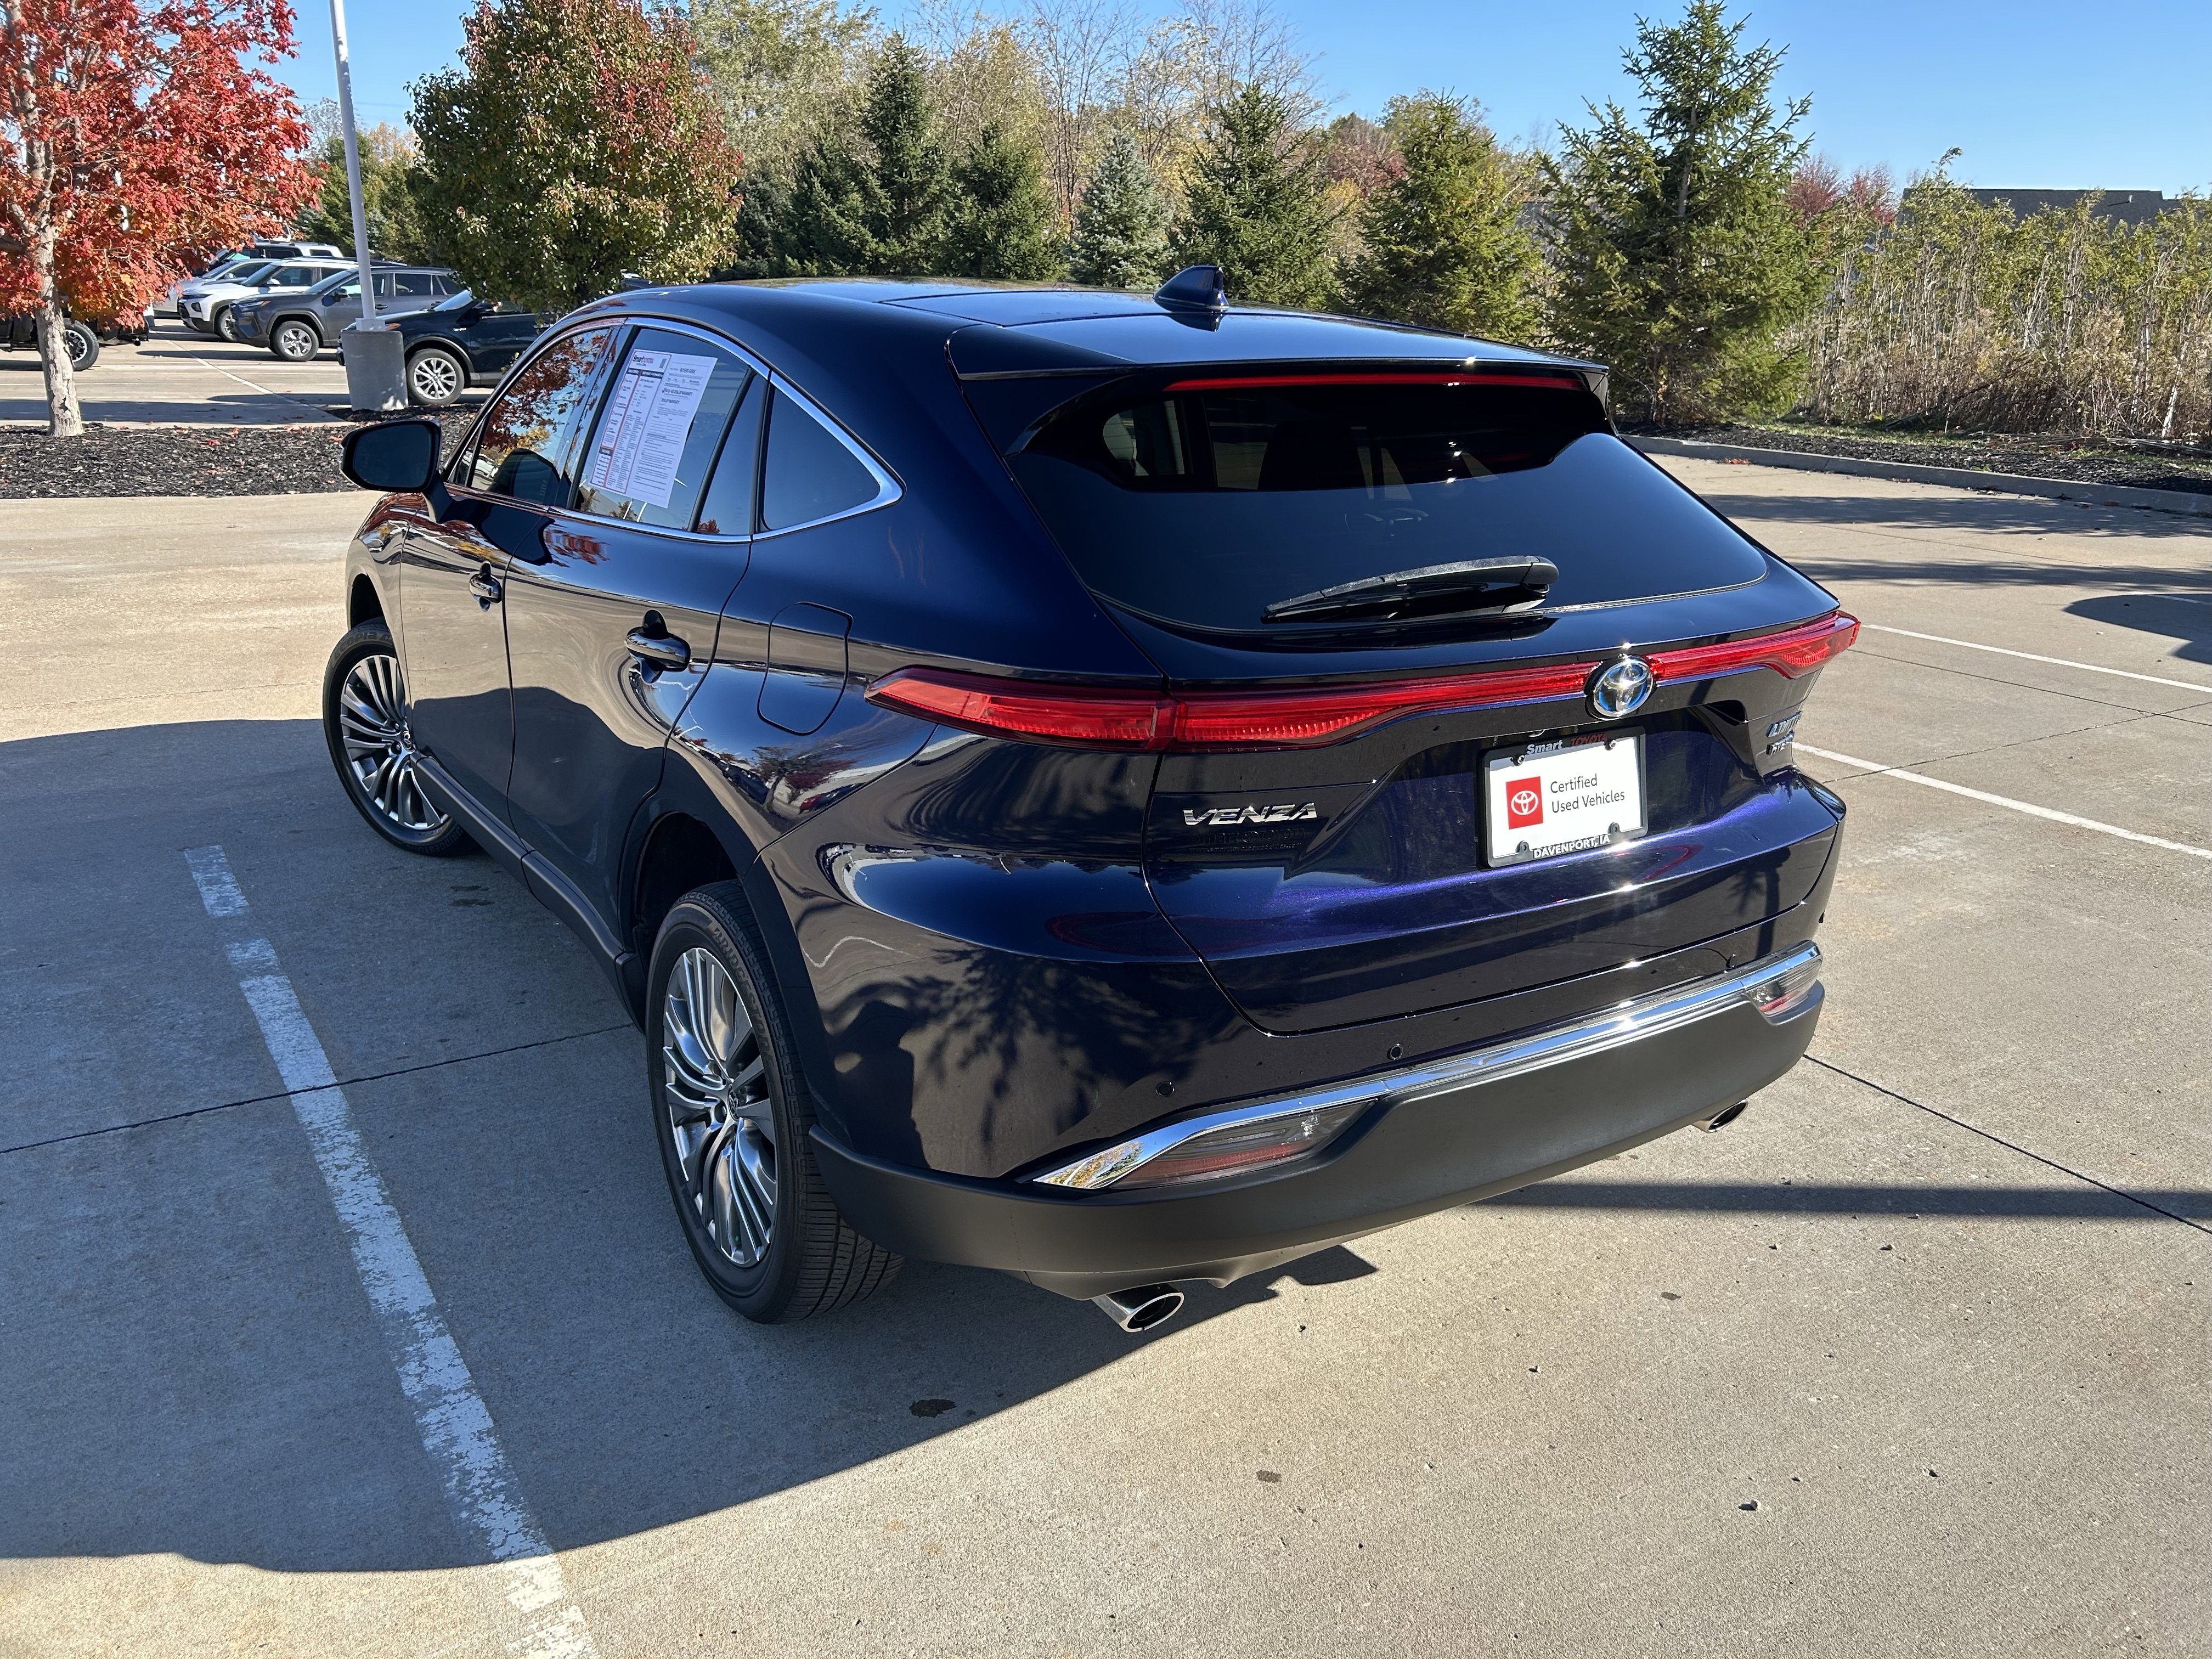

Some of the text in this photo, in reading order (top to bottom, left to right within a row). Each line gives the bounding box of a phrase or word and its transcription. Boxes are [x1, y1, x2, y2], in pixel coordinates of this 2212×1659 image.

[1526, 732, 1607, 755] Smart TOYOTA
[1550, 773, 1598, 793] Certified
[1551, 790, 1625, 813] Used Vehicles
[1182, 802, 1317, 825] VENZA
[1533, 834, 1610, 859] DAVENPORT, IA
